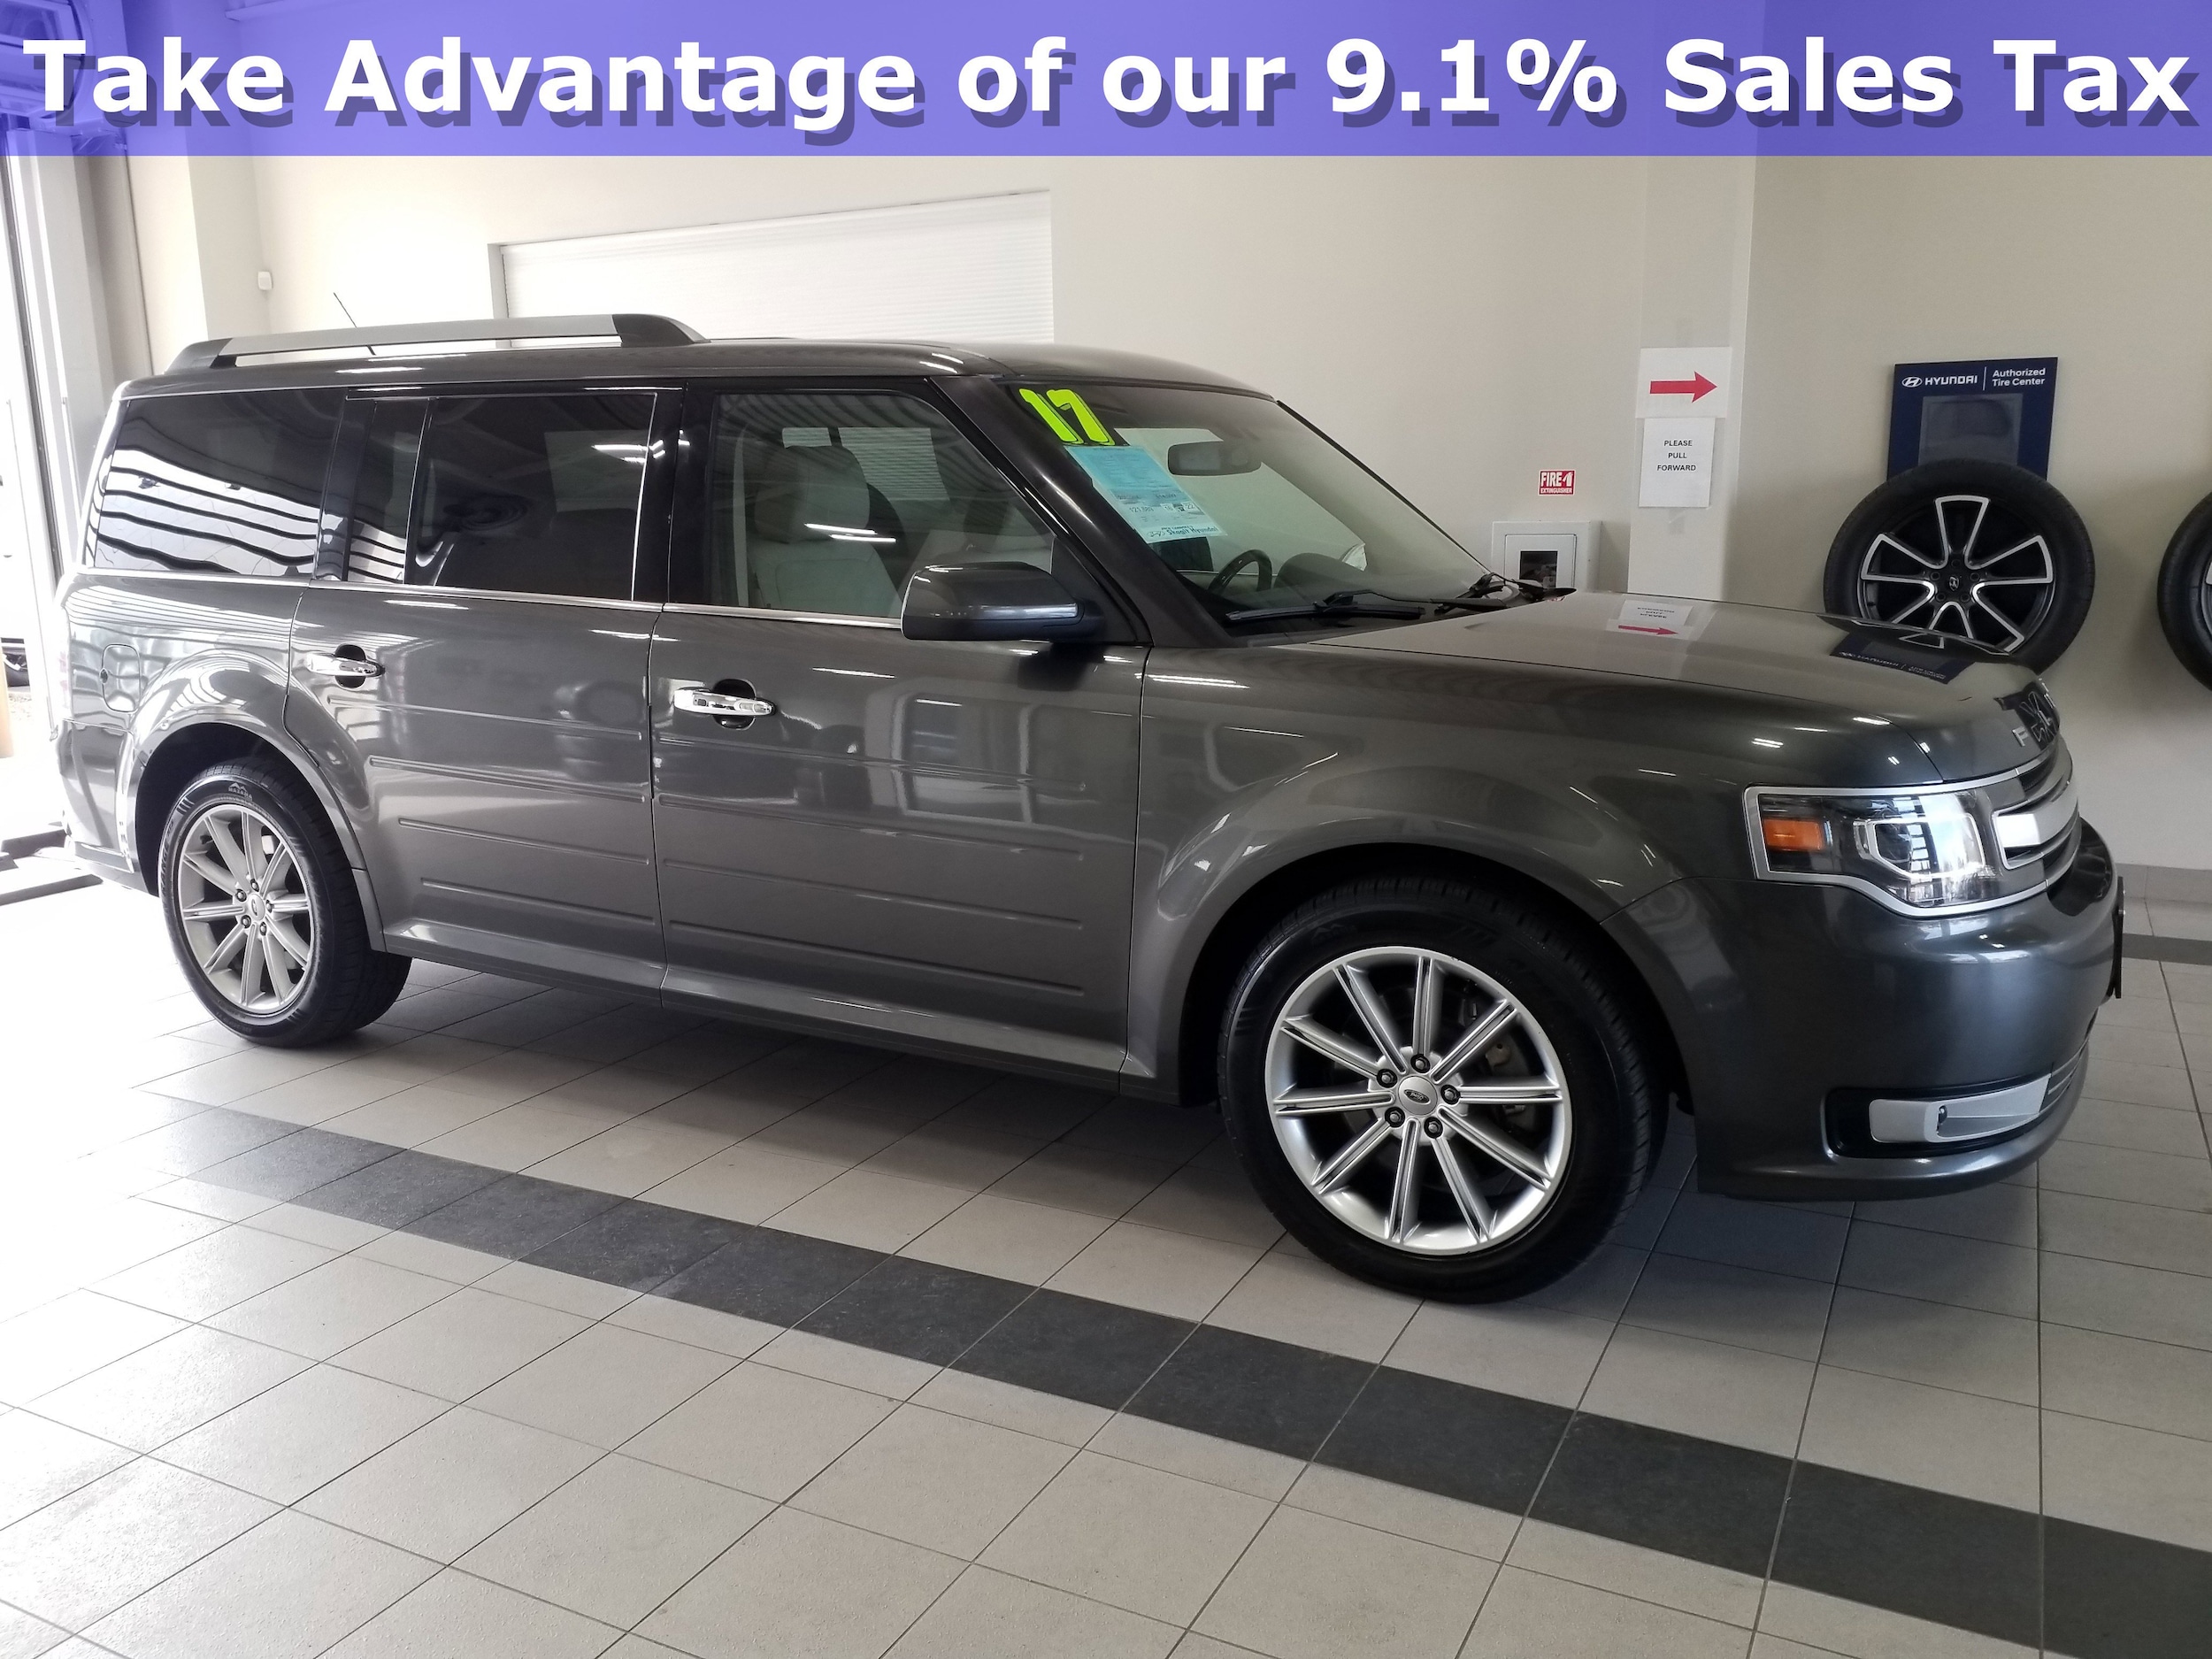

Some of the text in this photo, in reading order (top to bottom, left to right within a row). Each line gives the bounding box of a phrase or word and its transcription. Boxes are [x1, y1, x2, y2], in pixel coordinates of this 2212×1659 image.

[1993, 367, 2047, 378] Authorized
[1924, 375, 1978, 386] HYUNDAI
[1992, 377, 2046, 388] Tire Center
[1019, 388, 1115, 445] 17
[1540, 472, 1563, 487] FIRE
